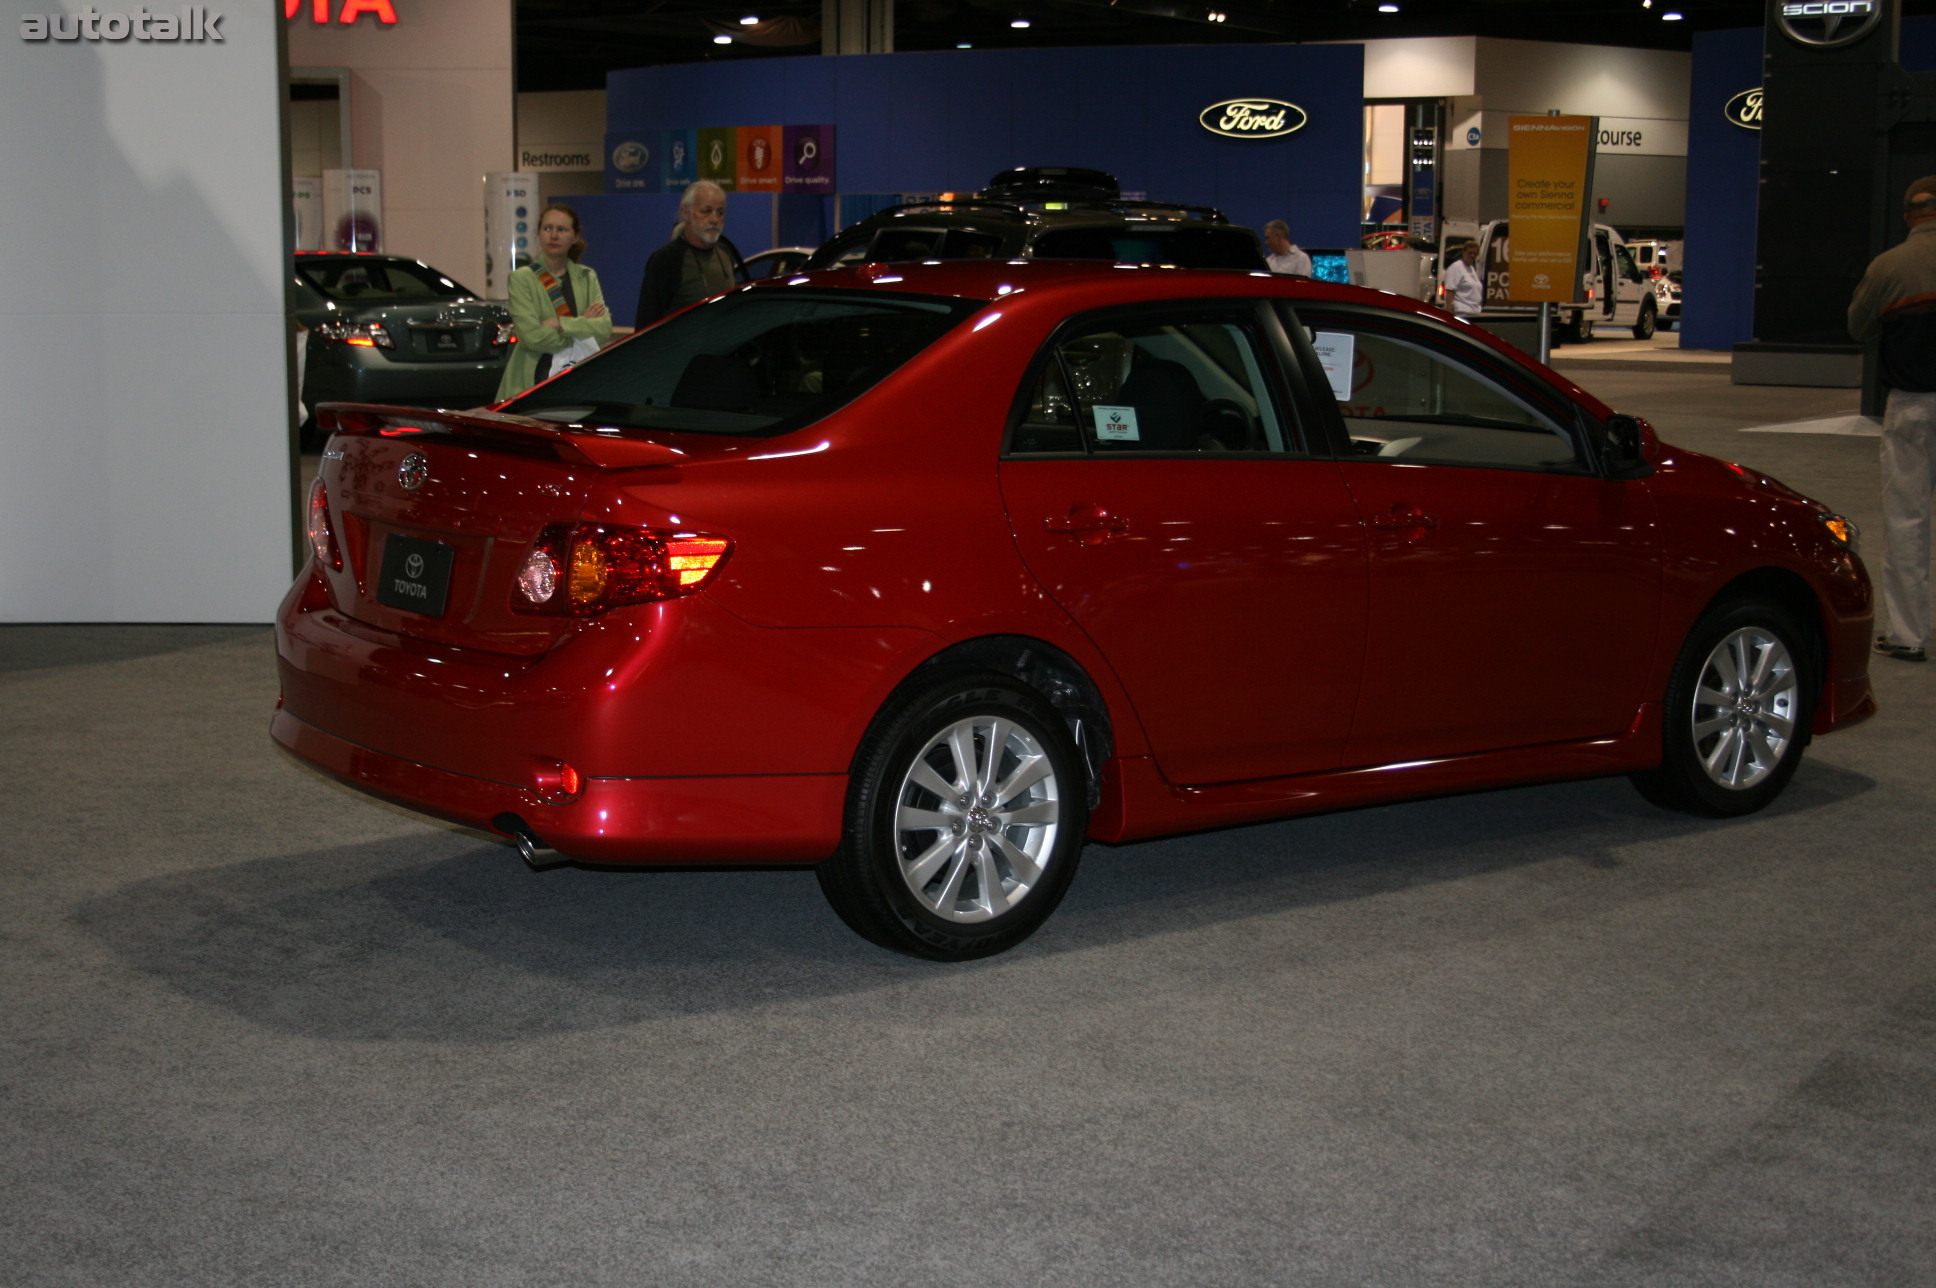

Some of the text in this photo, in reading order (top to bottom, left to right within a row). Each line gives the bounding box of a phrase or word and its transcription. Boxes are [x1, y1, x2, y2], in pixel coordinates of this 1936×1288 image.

[1219, 103, 1286, 131] Ford
[522, 152, 591, 167] Restrooms
[785, 176, 830, 186] Drive quality.
[1516, 179, 1575, 191] Create your
[1540, 190, 1574, 199] Sienna
[1515, 201, 1575, 210] commercial
[394, 579, 427, 599] TOYOTA
